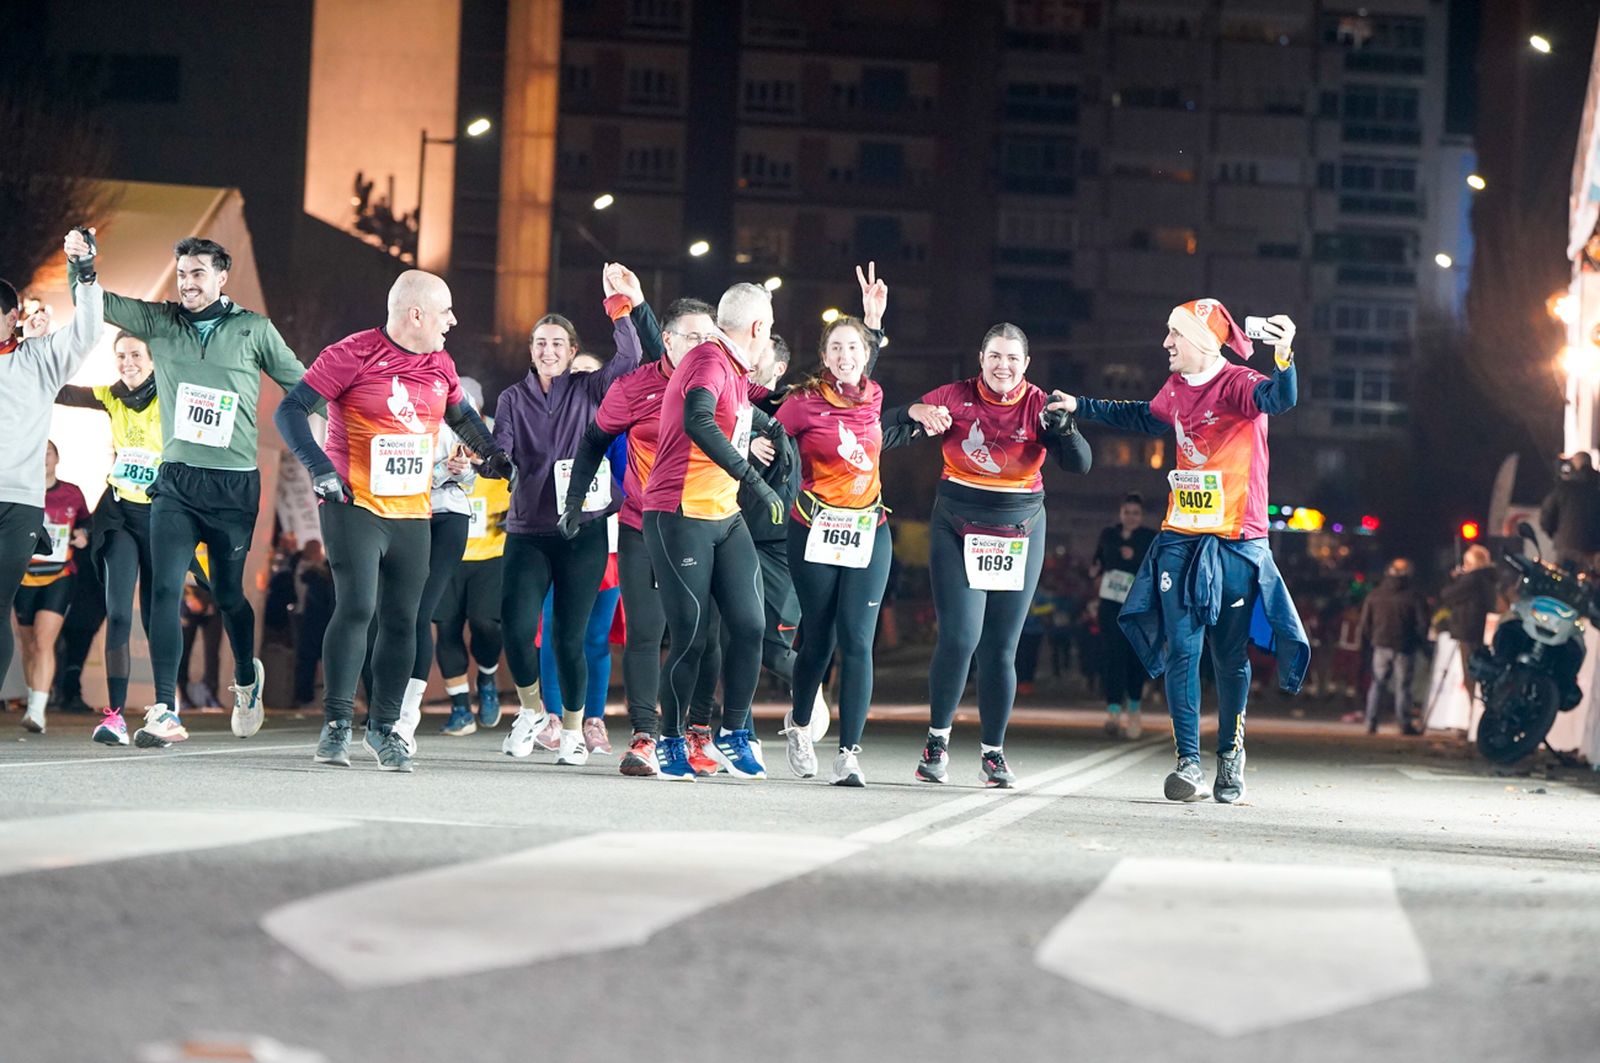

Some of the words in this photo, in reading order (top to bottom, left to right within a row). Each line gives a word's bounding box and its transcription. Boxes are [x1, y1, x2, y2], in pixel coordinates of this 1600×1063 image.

[187, 404, 222, 427] 7061
[399, 406, 414, 423] 43
[850, 450, 864, 464] 43
[971, 448, 988, 464] 43
[124, 463, 154, 481] 7875
[385, 457, 423, 475] 4375
[1180, 490, 1213, 508] 6402
[822, 529, 861, 548] 1694
[977, 555, 1014, 571] 1693
